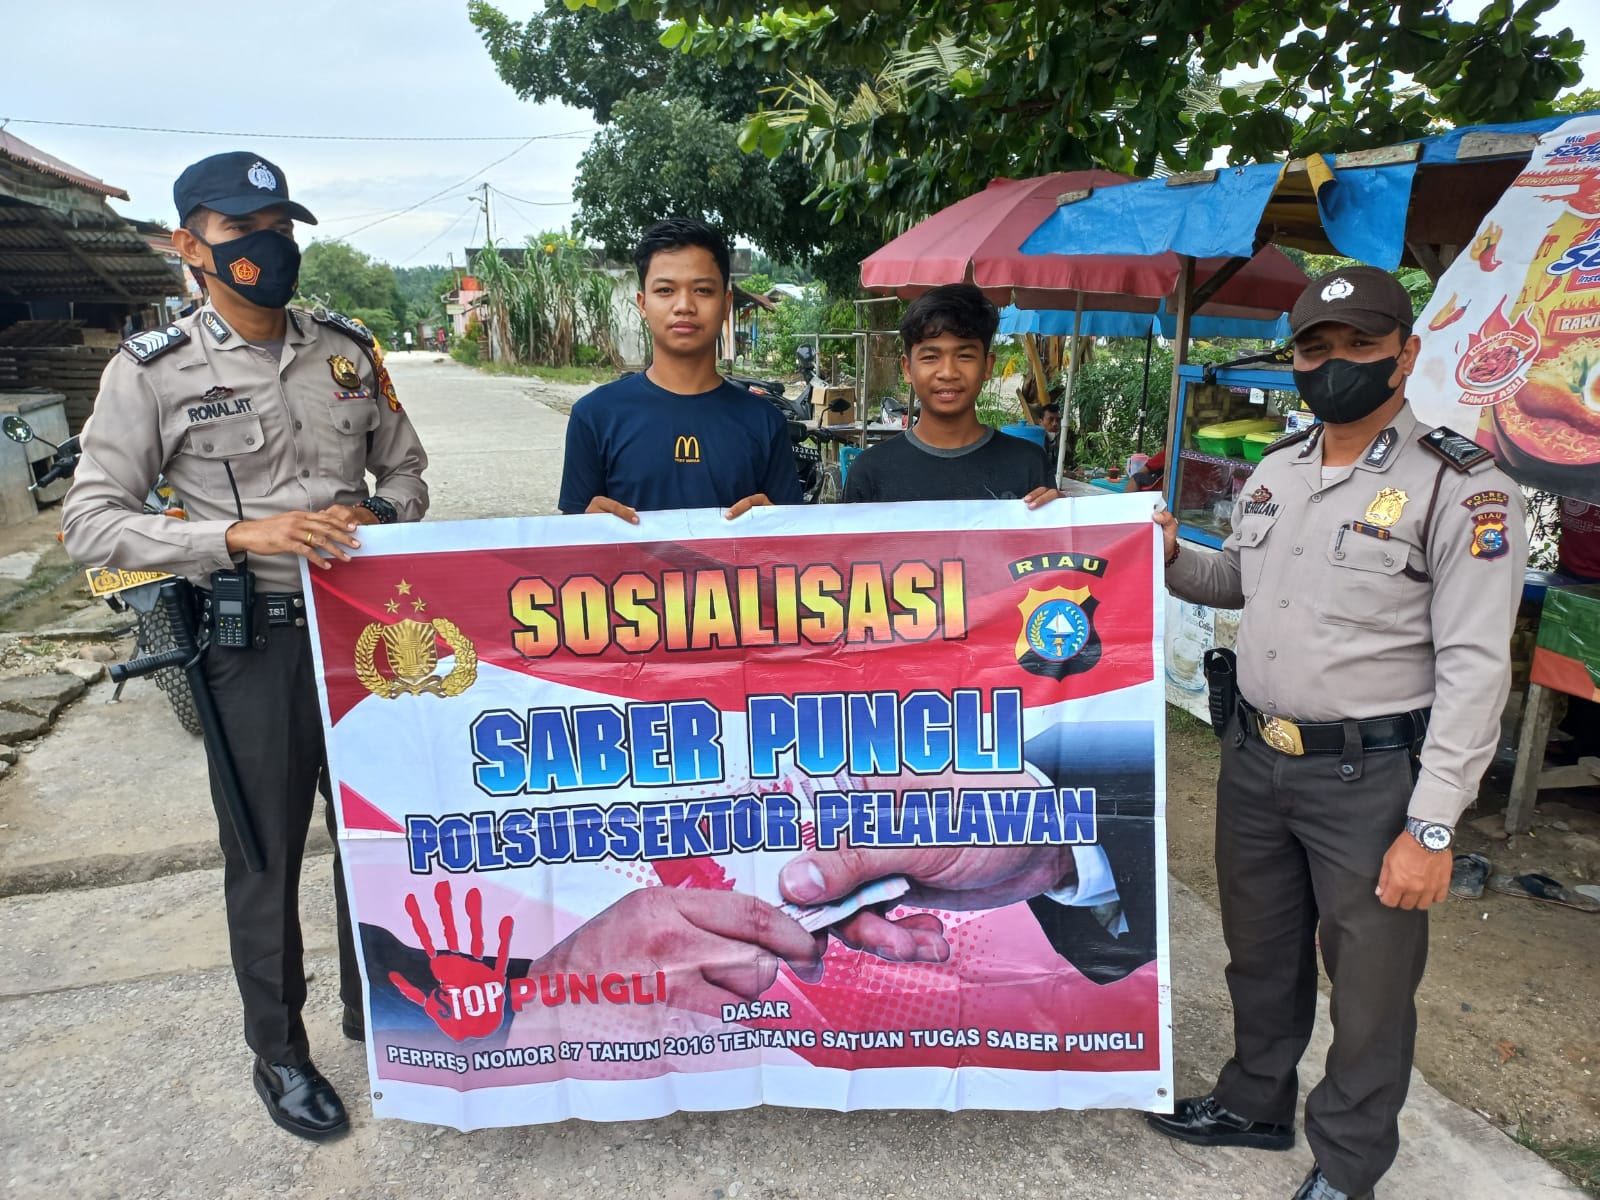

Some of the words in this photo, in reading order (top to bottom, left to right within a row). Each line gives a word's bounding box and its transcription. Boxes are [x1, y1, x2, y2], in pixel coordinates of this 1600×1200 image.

[1565, 135, 1586, 144] Mie
[1461, 393, 1496, 404] RAWIT
[1499, 378, 1522, 399] ASLI
[187, 397, 253, 423] RONAL.HT
[1477, 512, 1502, 521] RIAU
[1015, 555, 1099, 575] RIAU
[508, 558, 967, 658] SOSIALISASI
[469, 698, 725, 796] SABER
[746, 687, 1024, 780] PUNGLI
[405, 791, 803, 875] POLSUBSEKTOR
[813, 785, 1098, 851] PELALAWAN
[432, 981, 504, 1020] STOP
[509, 971, 667, 1013] PUNGLI
[722, 1001, 791, 1023] DASAR
[386, 1044, 469, 1074] PERPRES
[473, 1045, 556, 1071] NOMOR
[559, 1040, 584, 1061] 87
[587, 1038, 661, 1061] TAHUN
[664, 1034, 716, 1056] 2016
[718, 1028, 816, 1052] TENTANG
[822, 1029, 905, 1052] SATUAN
[910, 1027, 981, 1049] TUGAS
[986, 1030, 1060, 1052] SABER
[1065, 1031, 1145, 1053] PUNGLI
